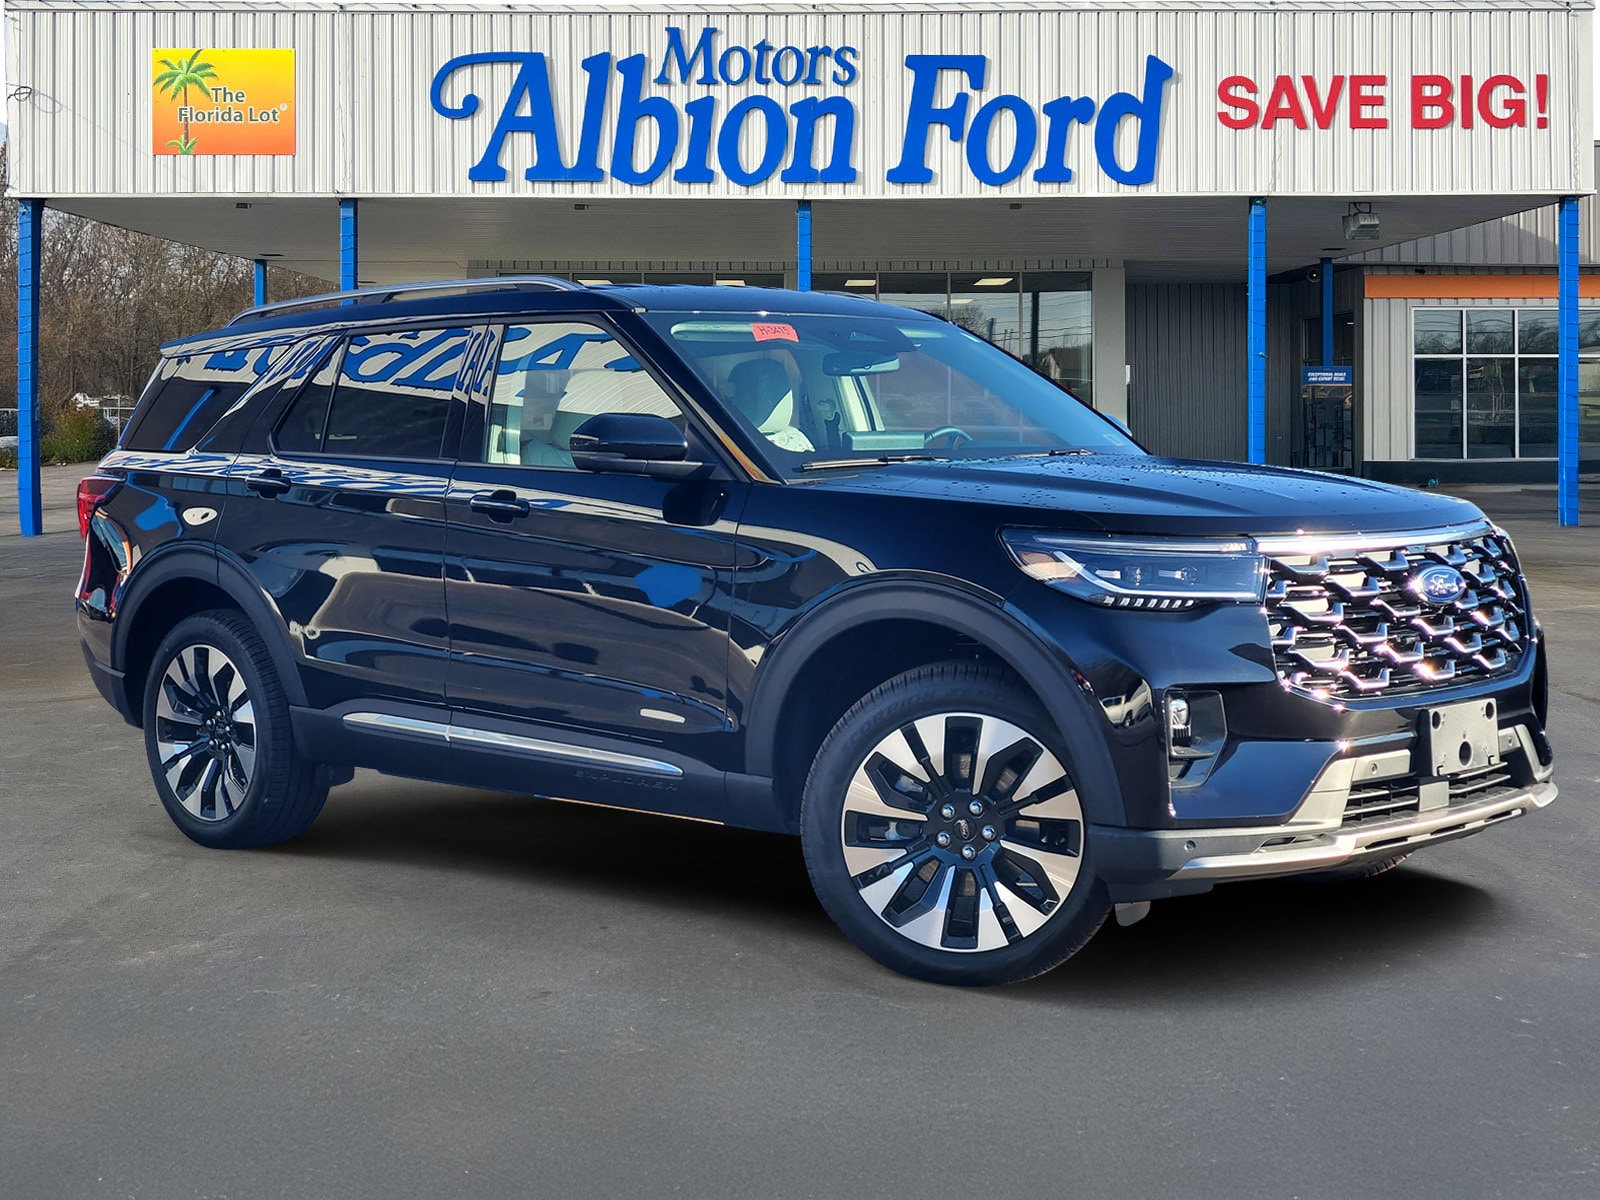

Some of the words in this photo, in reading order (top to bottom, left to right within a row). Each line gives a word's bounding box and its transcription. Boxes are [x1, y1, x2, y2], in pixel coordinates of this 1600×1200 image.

[654, 27, 857, 85] Motors
[178, 106, 243, 122] Florida
[211, 86, 245, 103] The
[430, 51, 857, 186] Albion
[887, 54, 1174, 186] Ford
[1217, 75, 1388, 129] SAVE
[1411, 74, 1548, 129] BIG!
